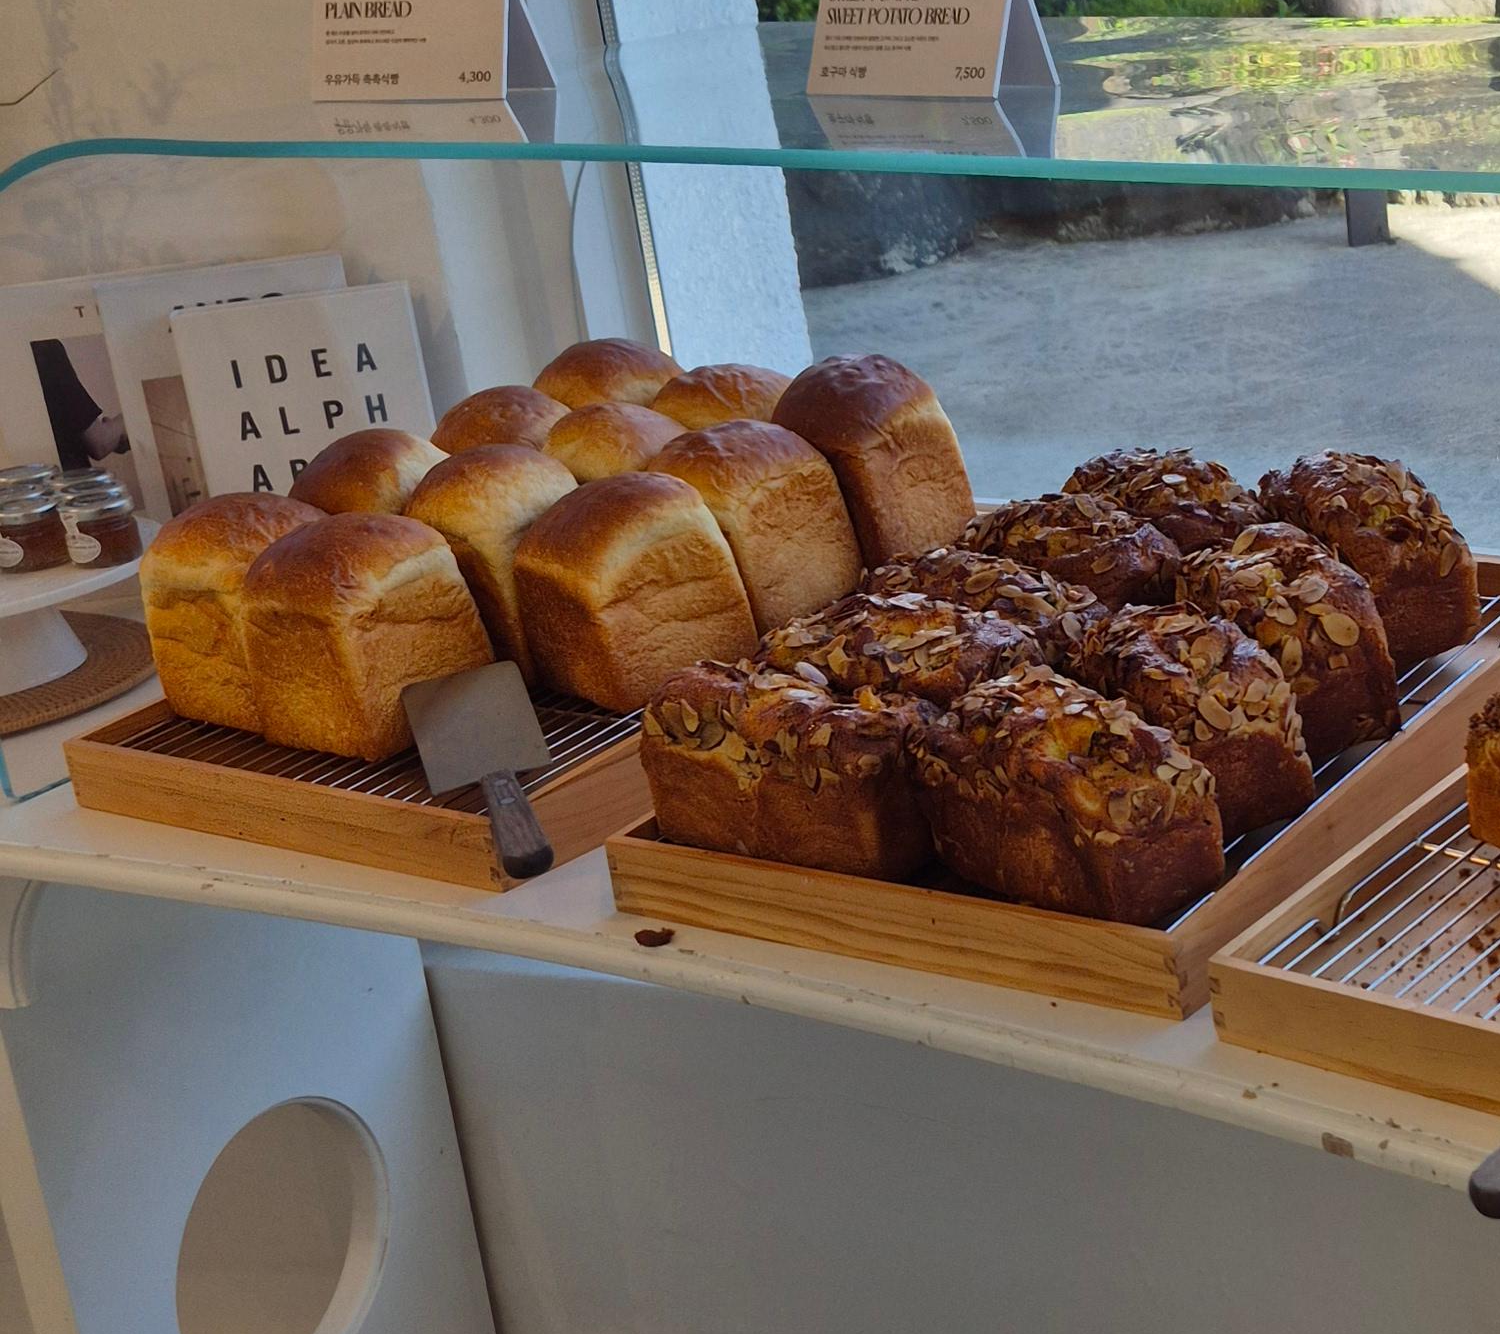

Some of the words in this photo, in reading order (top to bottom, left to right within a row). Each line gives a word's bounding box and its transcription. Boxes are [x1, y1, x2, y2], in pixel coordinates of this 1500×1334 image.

[325, 1, 362, 19] PLAIN
[365, 0, 412, 18] BREAD
[826, 7, 865, 25] SWEET
[867, 7, 923, 25] POTATO
[924, 7, 970, 25] BREAD
[324, 73, 360, 86] 우유가득
[458, 70, 491, 84] 4,300
[849, 66, 867, 78] 식빵
[954, 66, 986, 80] 7,500
[230, 343, 378, 389] IDEA
[240, 393, 388, 441] ALPH
